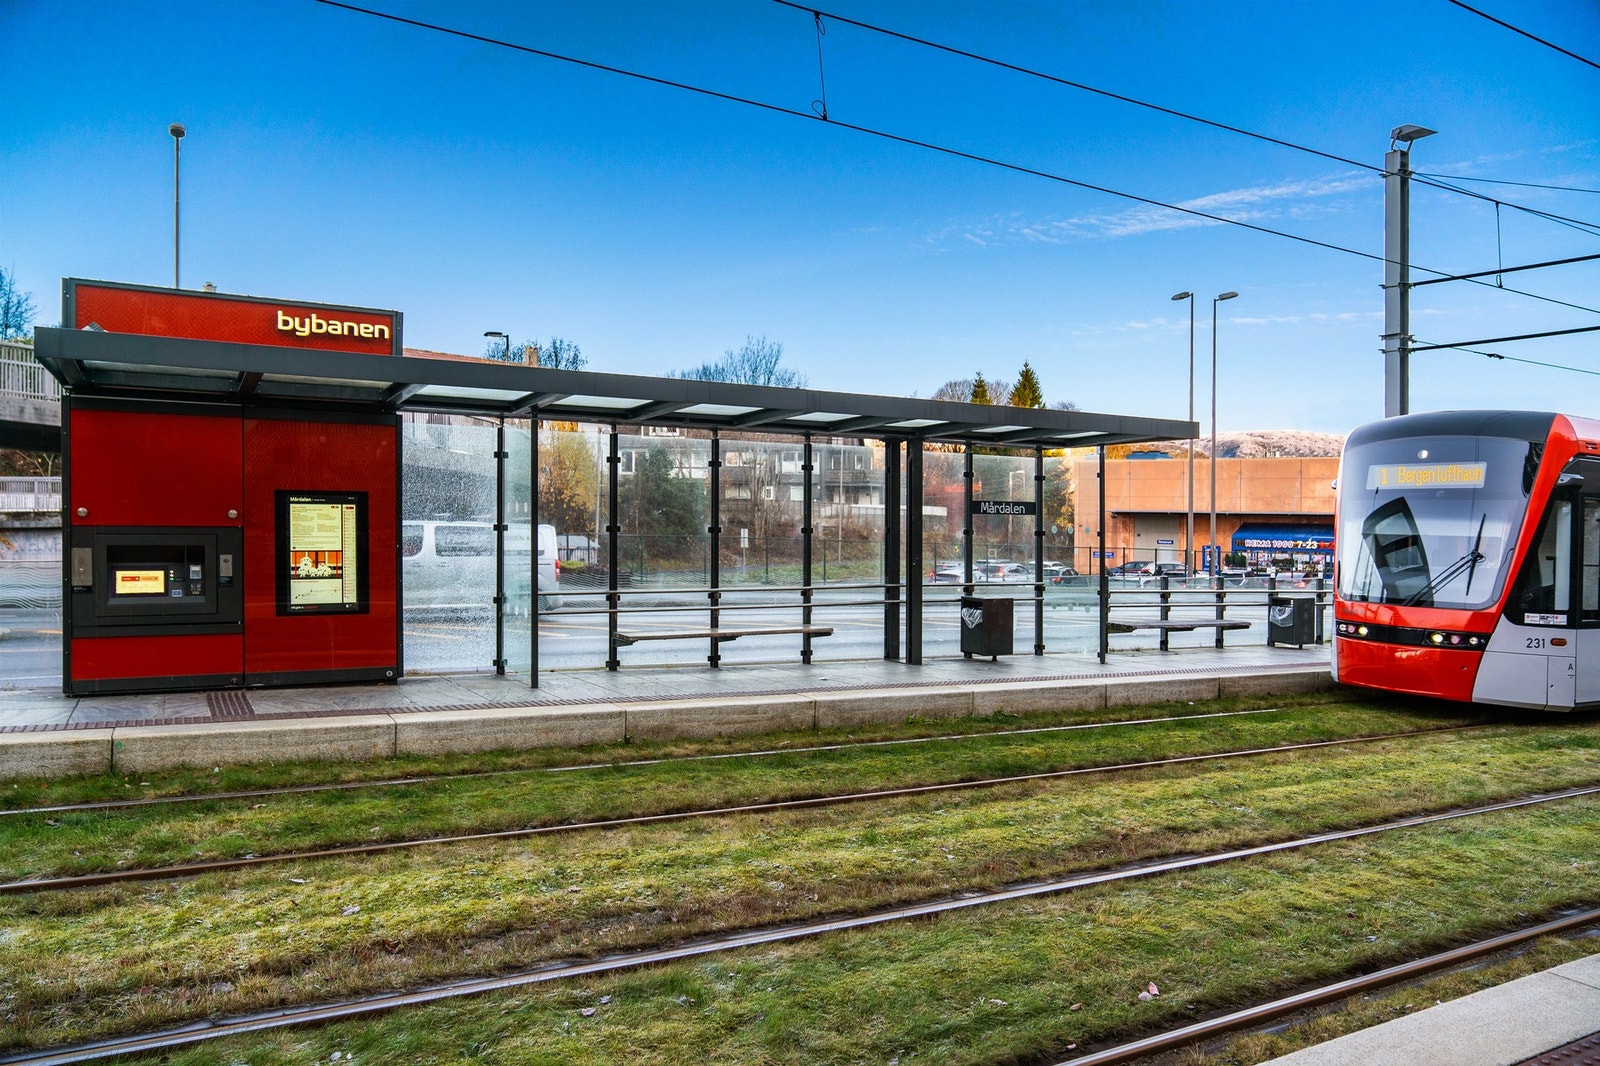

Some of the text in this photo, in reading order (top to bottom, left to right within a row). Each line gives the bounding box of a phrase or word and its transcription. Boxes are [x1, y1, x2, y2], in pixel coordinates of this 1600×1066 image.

[277, 310, 390, 339] bybanen
[1381, 464, 1483, 486] 1 Bergen lufthavn
[980, 501, 1026, 514] Mårdalen
[1272, 540, 1294, 548] 1000
[1526, 637, 1546, 649] 231
[1567, 663, 1574, 671] A
